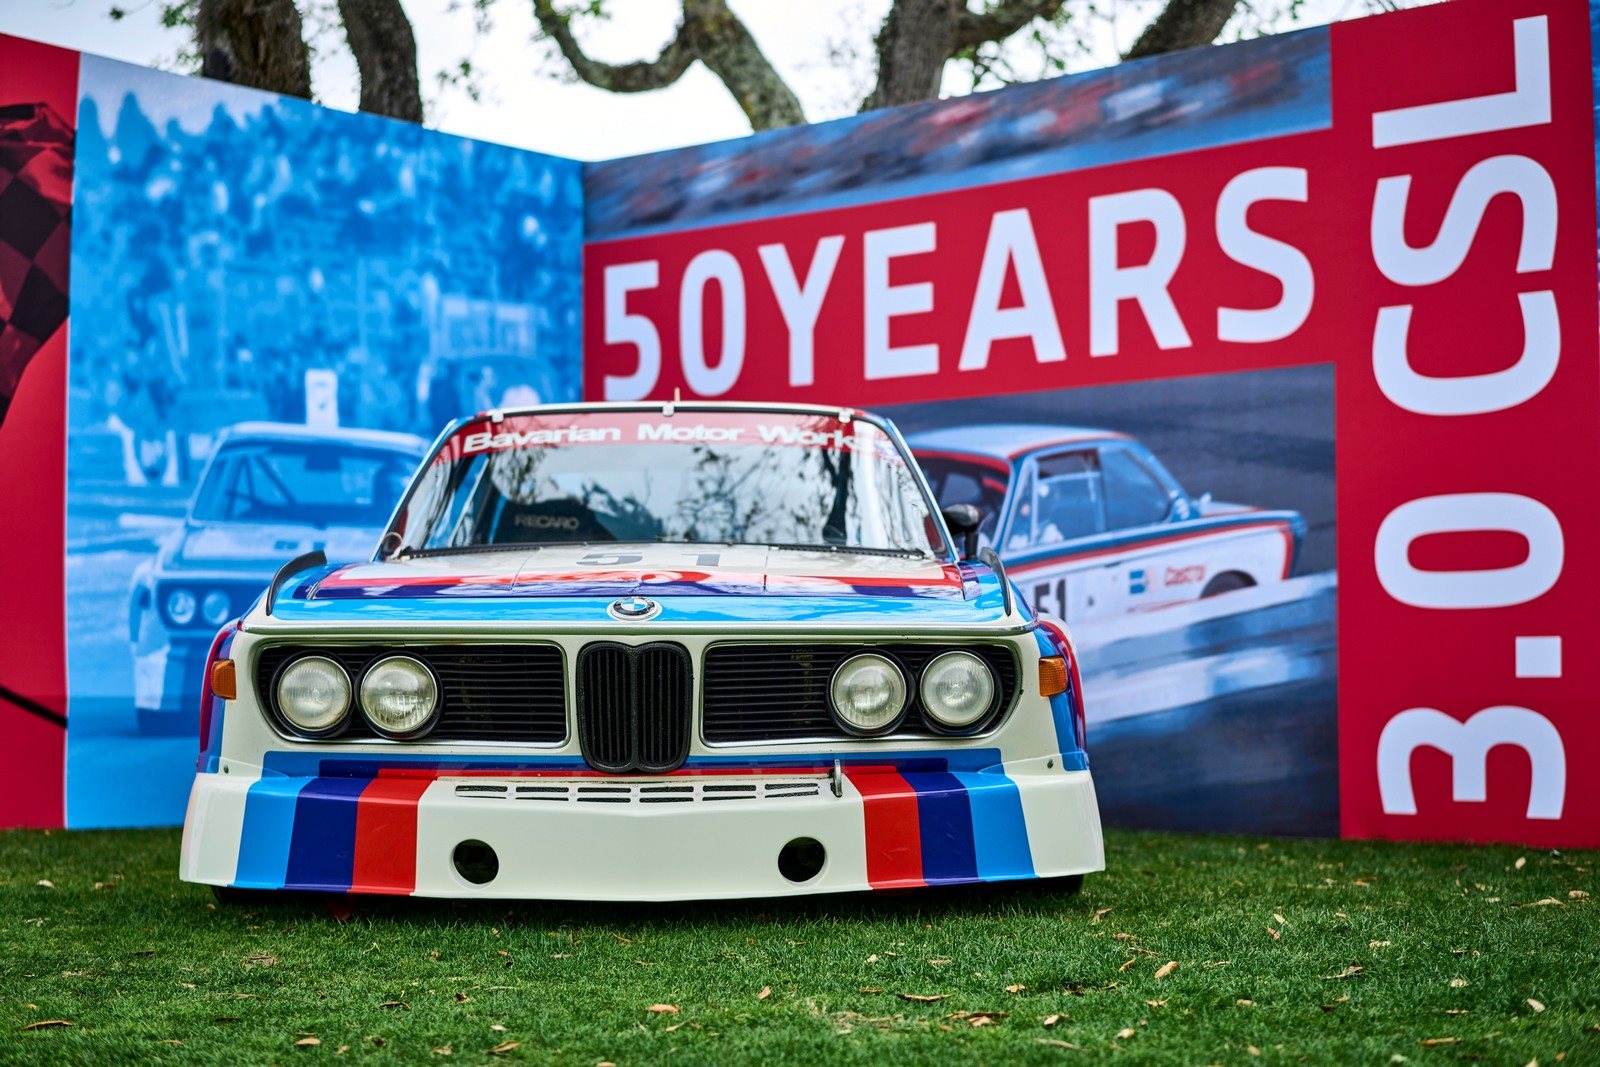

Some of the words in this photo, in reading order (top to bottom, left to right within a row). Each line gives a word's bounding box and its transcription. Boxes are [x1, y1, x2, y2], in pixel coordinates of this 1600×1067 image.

[1371, 15, 1561, 416] CSL
[464, 426, 621, 453] Bavarian
[637, 423, 745, 441] Motor
[514, 514, 580, 530] RECARO
[1374, 492, 1566, 820] 3.0
